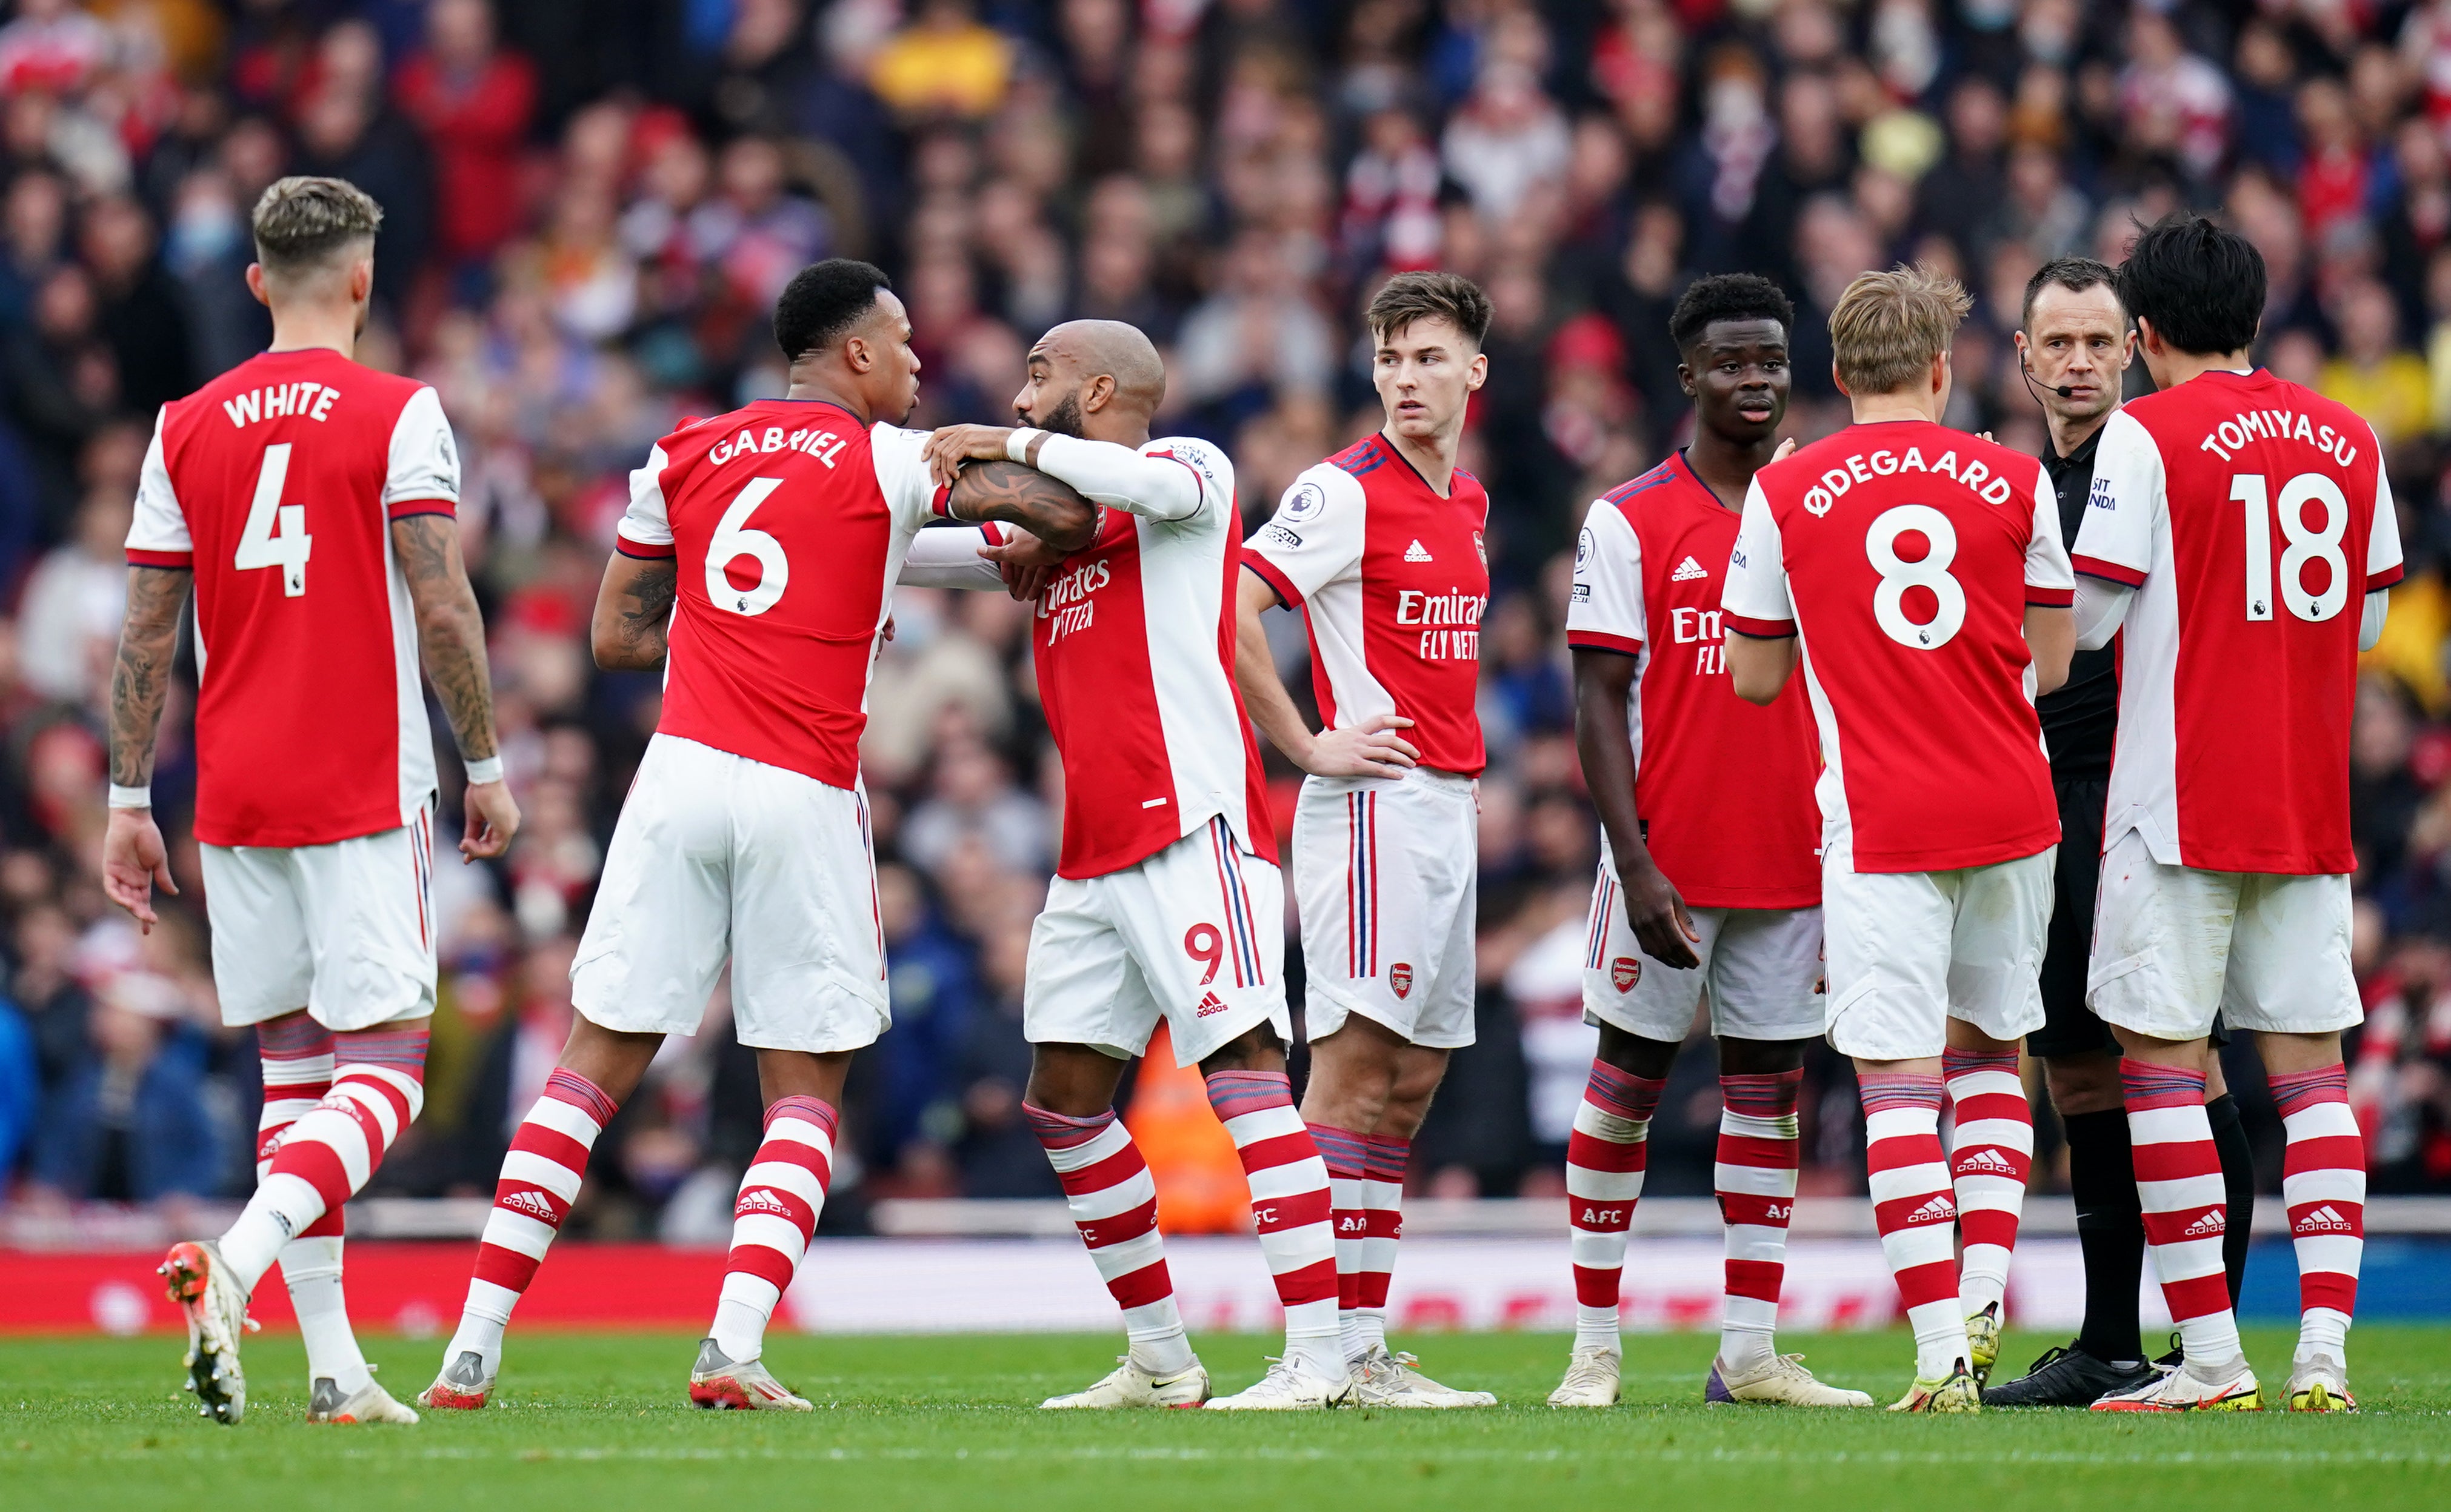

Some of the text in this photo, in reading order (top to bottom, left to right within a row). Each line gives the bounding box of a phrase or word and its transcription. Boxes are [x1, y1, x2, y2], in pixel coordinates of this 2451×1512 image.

[223, 382, 341, 428] WHITE
[709, 427, 847, 469] GABRIEL
[2200, 410, 2357, 467] TOMIYASU
[1803, 447, 2011, 518] ØDEGAARD
[234, 442, 312, 597] 4
[705, 476, 789, 616] 6
[1404, 554, 1433, 562] adidas
[2229, 473, 2349, 622] 18
[1671, 570, 1708, 582] adidas
[1865, 504, 1967, 650] 8
[1420, 630, 1448, 659] FLY
[1184, 922, 1223, 987] 9
[1197, 1004, 1229, 1018] adidas
[1957, 1162, 2016, 1175] adidas
[502, 1196, 558, 1222] adidas
[736, 1202, 792, 1217] adidas
[1581, 1208, 1622, 1224] AFC
[2295, 1221, 2352, 1231] adidas
